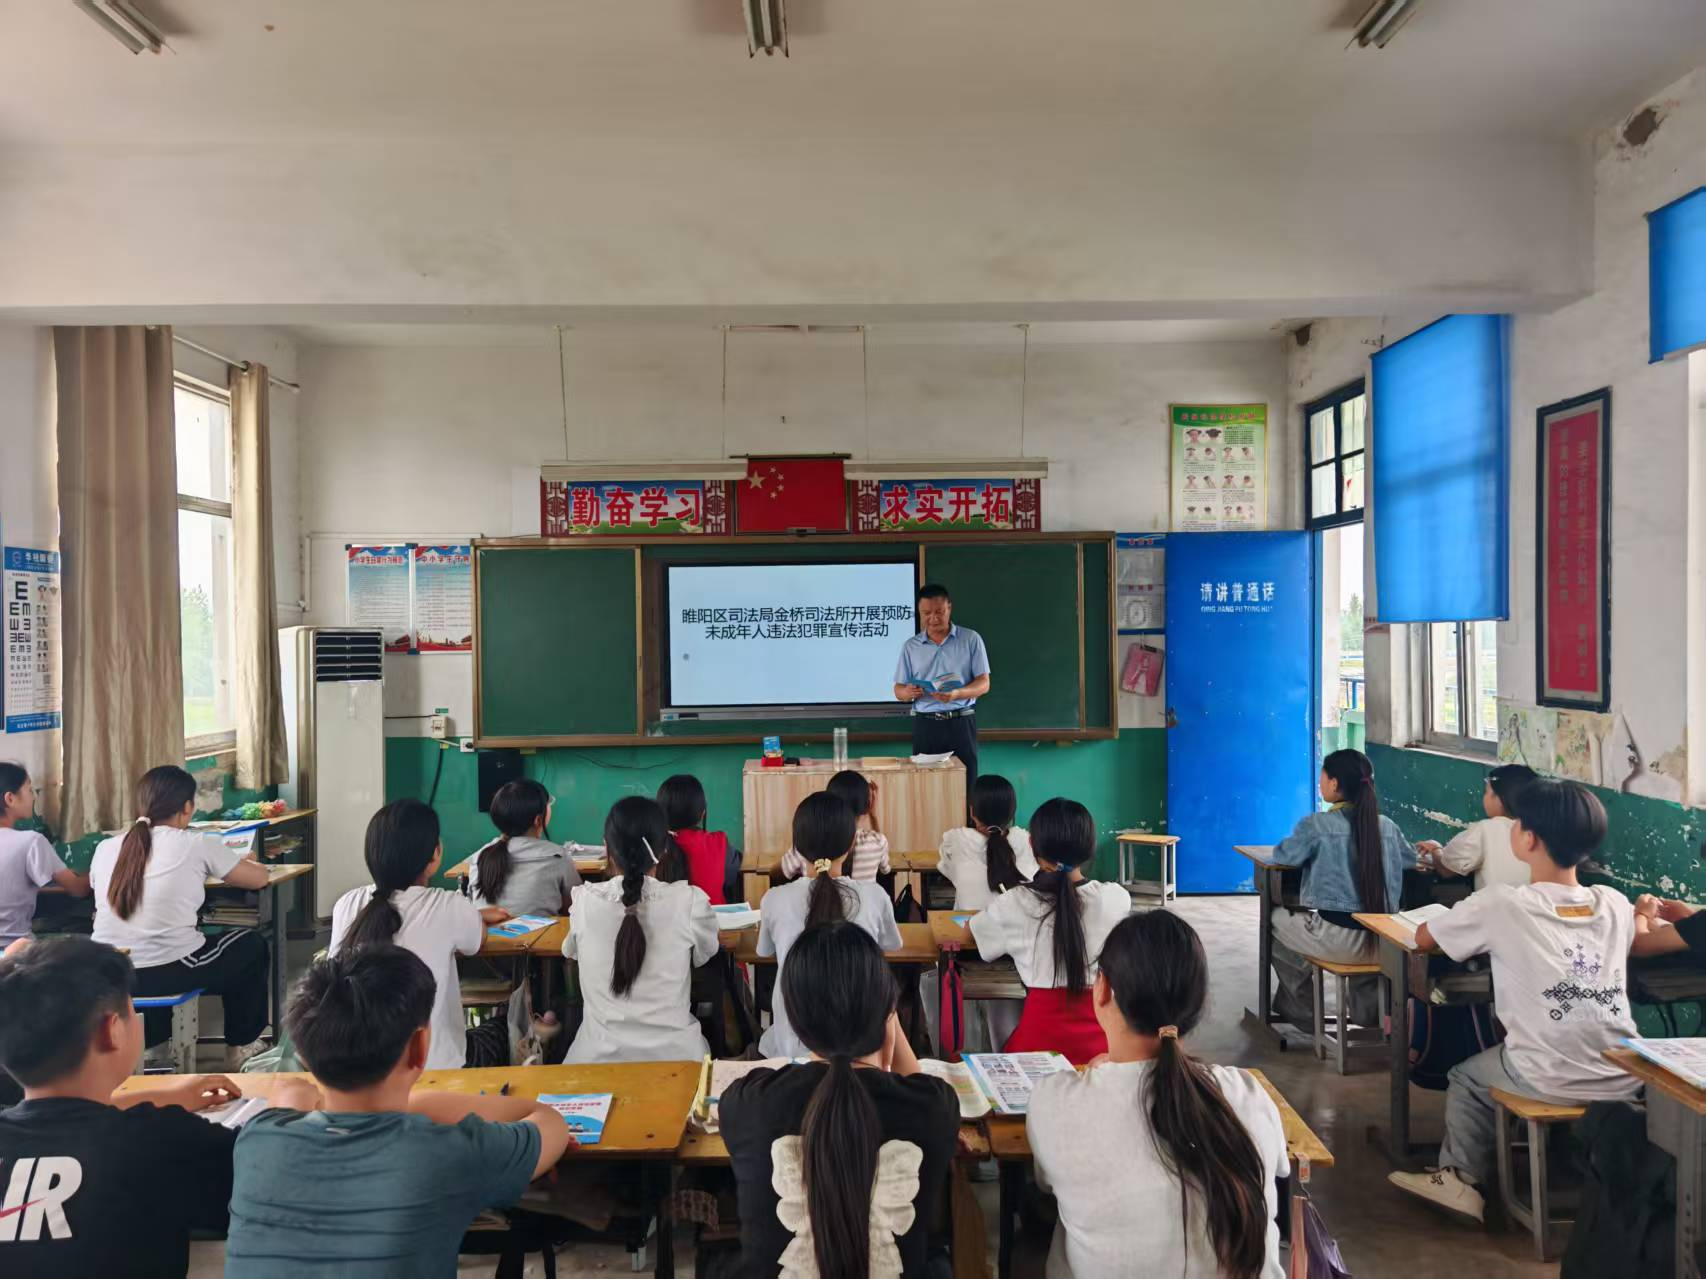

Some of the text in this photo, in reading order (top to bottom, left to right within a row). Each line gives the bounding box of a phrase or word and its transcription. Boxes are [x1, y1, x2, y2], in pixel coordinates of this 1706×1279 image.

[571, 485, 702, 529] 勤奋学习
[882, 484, 1012, 526] 求实开拓
[1200, 582, 1275, 602] 请讲普通话
[682, 605, 912, 624] 睢阳区司法局金桥司法所开展预防
[705, 621, 889, 640] 未成年人违法犯罪宣传活动
[0, 1156, 83, 1241] IR
